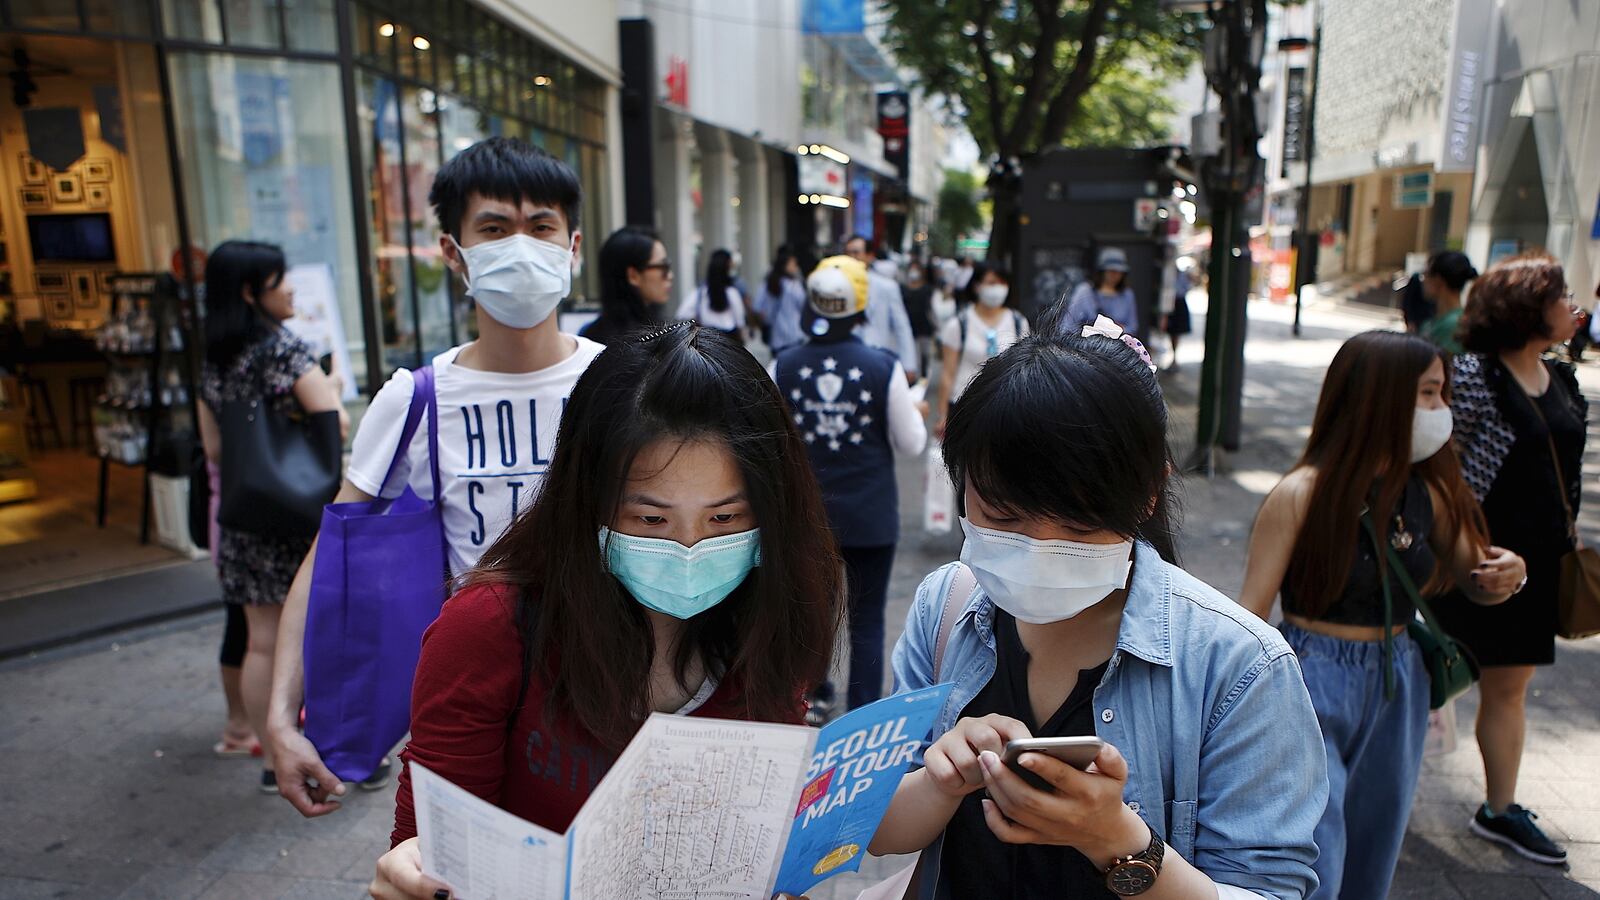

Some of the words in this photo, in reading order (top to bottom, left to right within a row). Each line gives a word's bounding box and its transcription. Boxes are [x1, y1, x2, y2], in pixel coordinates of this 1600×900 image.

[461, 398, 571, 469] HOL
[806, 716, 909, 780] SEOUL
[837, 740, 922, 786] TOUR
[802, 778, 873, 829] MAP
